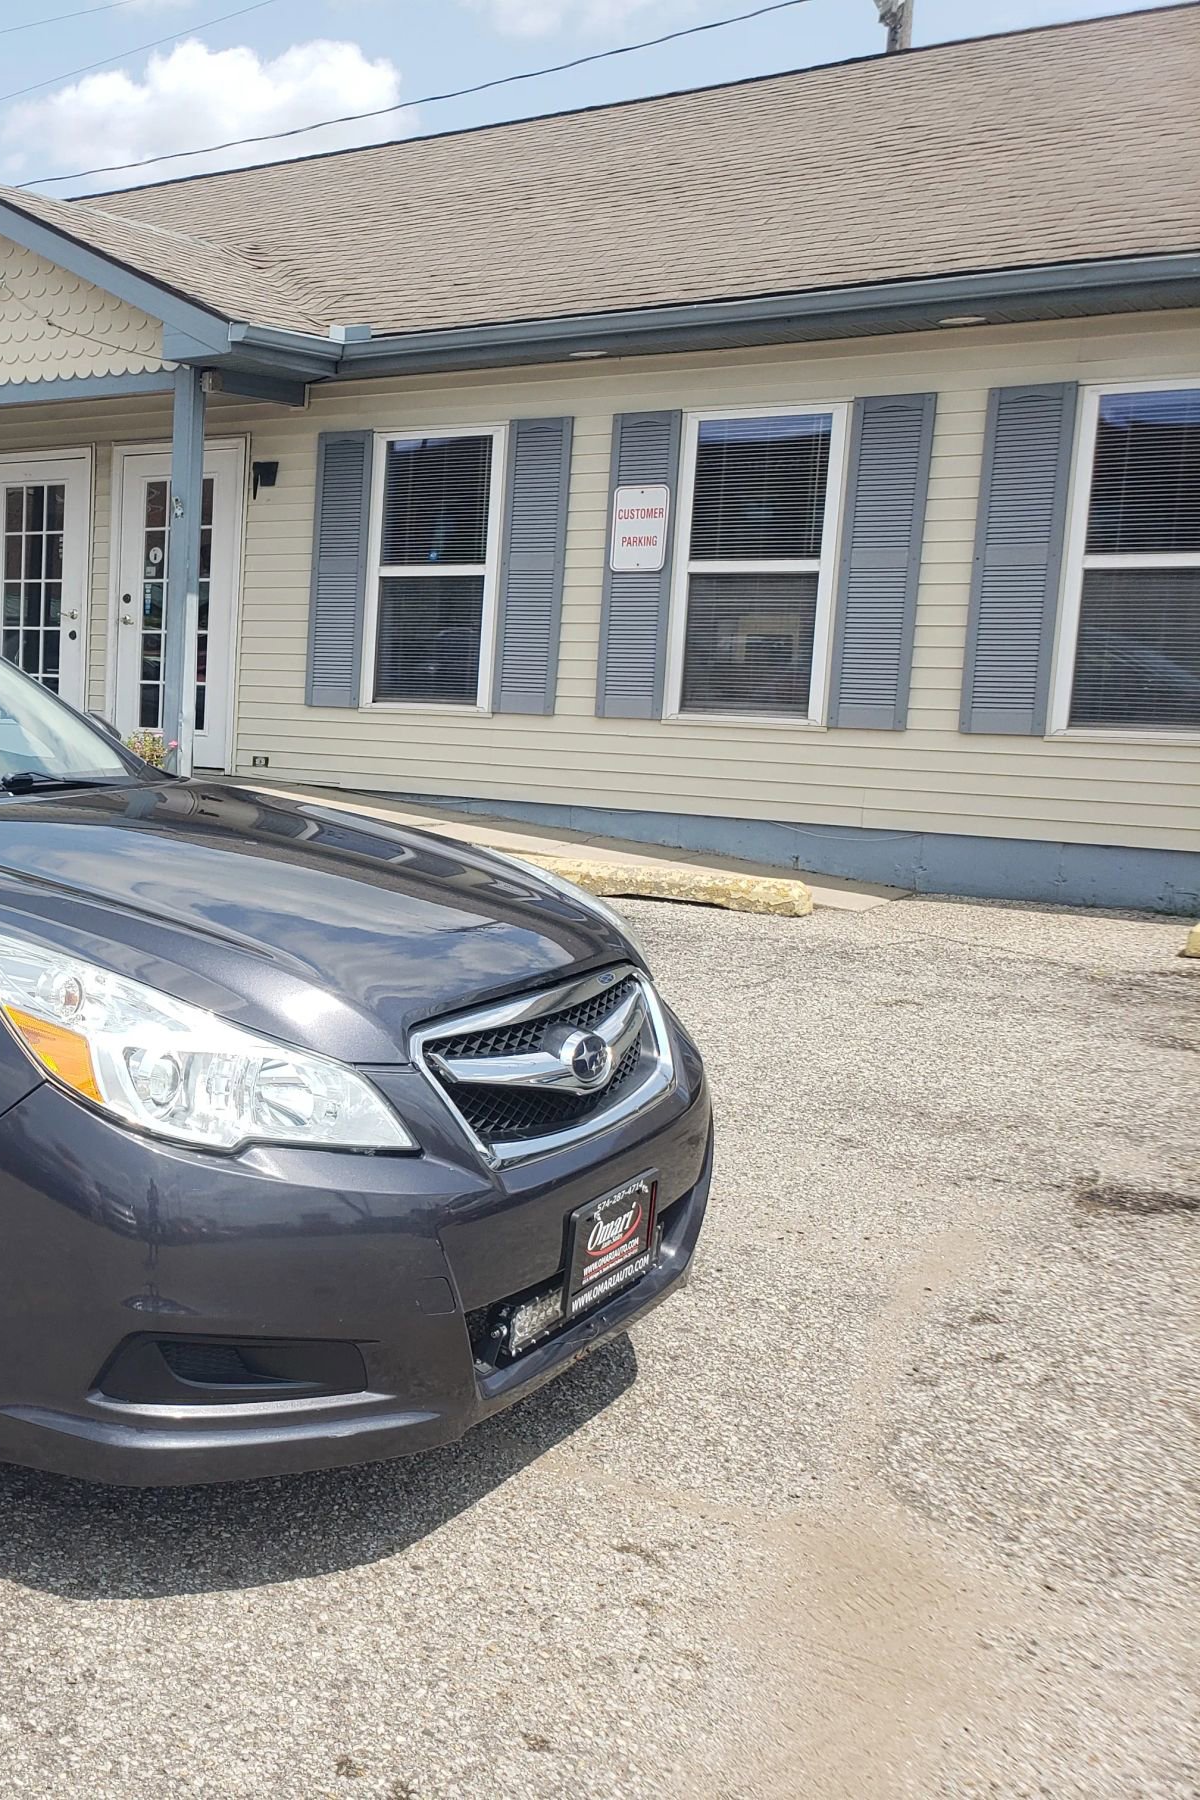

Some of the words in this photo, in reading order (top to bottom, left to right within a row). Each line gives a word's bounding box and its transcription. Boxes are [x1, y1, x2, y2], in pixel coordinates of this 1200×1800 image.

[617, 507, 664, 520] CUSTOMER
[621, 535, 658, 547] PARKING
[587, 1202, 636, 1251] Omari
[571, 1254, 650, 1313] WWW.OMARIAUTO.COM
